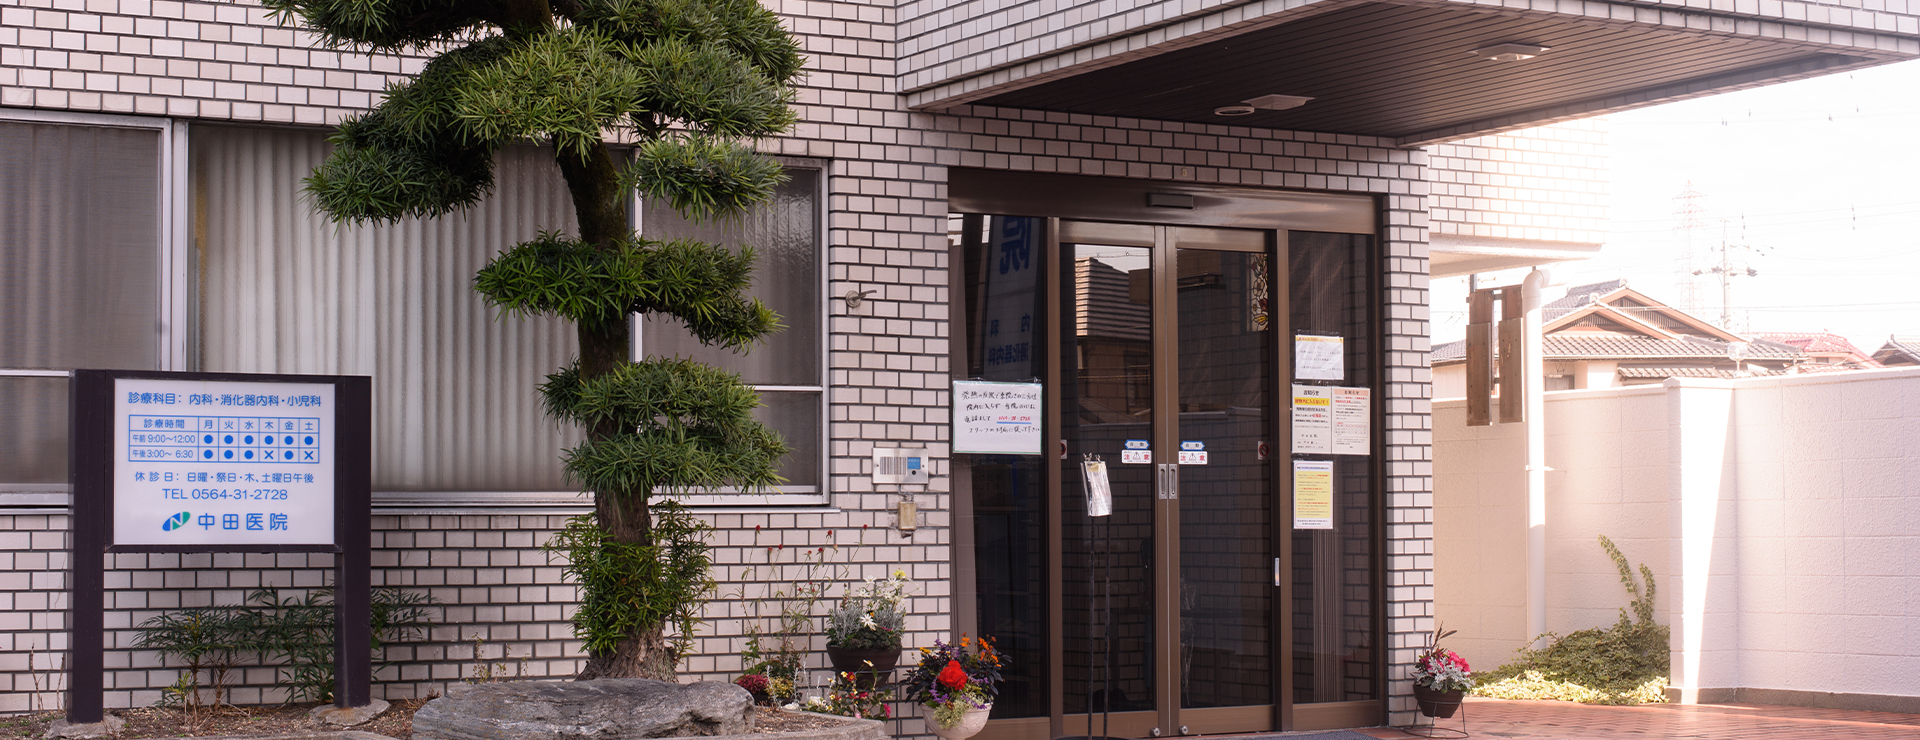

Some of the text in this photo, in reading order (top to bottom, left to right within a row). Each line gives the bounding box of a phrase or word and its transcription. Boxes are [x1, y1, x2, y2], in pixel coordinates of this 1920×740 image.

[143, 418, 185, 430] 診療時間
[203, 420, 314, 431] 月 火 水 木 金 土
[162, 488, 288, 501] TEL 0564-31-2728
[198, 512, 288, 531] 中田医院
